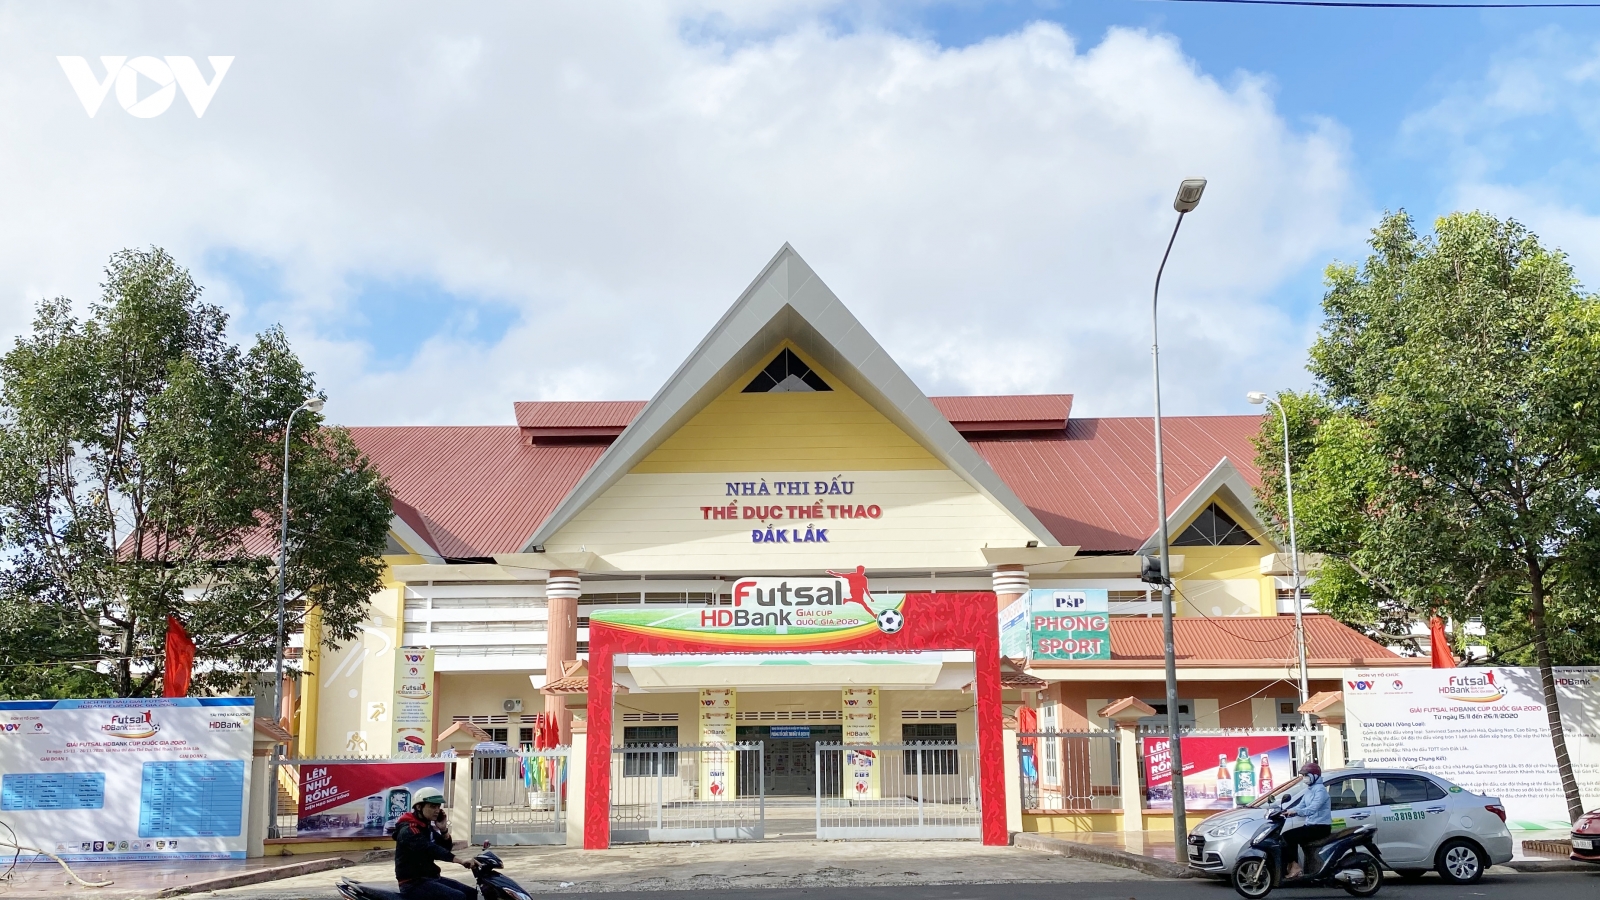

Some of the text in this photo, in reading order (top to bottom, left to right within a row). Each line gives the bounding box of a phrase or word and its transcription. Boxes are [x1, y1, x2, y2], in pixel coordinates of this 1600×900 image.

[726, 474, 854, 496] NHÀ THI ĐẤU
[700, 498, 882, 523] THỂ DỤC THỂ THAO
[752, 523, 828, 543] ĐẮK LẮK
[734, 580, 843, 607] Futsal
[701, 608, 792, 627] HDBank
[820, 618, 835, 626] GIA
[836, 618, 859, 626] 2020
[1034, 615, 1107, 631] PHONG
[1038, 638, 1104, 654] SPORT
[1347, 681, 1375, 690] VOV
[1449, 676, 1487, 686] Futsal
[1555, 678, 1591, 686] HDBank
[1477, 704, 1490, 712] CÚP
[1492, 704, 1510, 712] QUỐC
[111, 715, 144, 724] Futsal
[1150, 740, 1170, 754] LÊN
[306, 767, 328, 781] LÊN
[1151, 760, 1172, 774] RỒN
[305, 776, 332, 792] NHƯ
[305, 786, 338, 803] RỒNG
[1401, 811, 1413, 820] 819
[1414, 811, 1426, 820] 819
